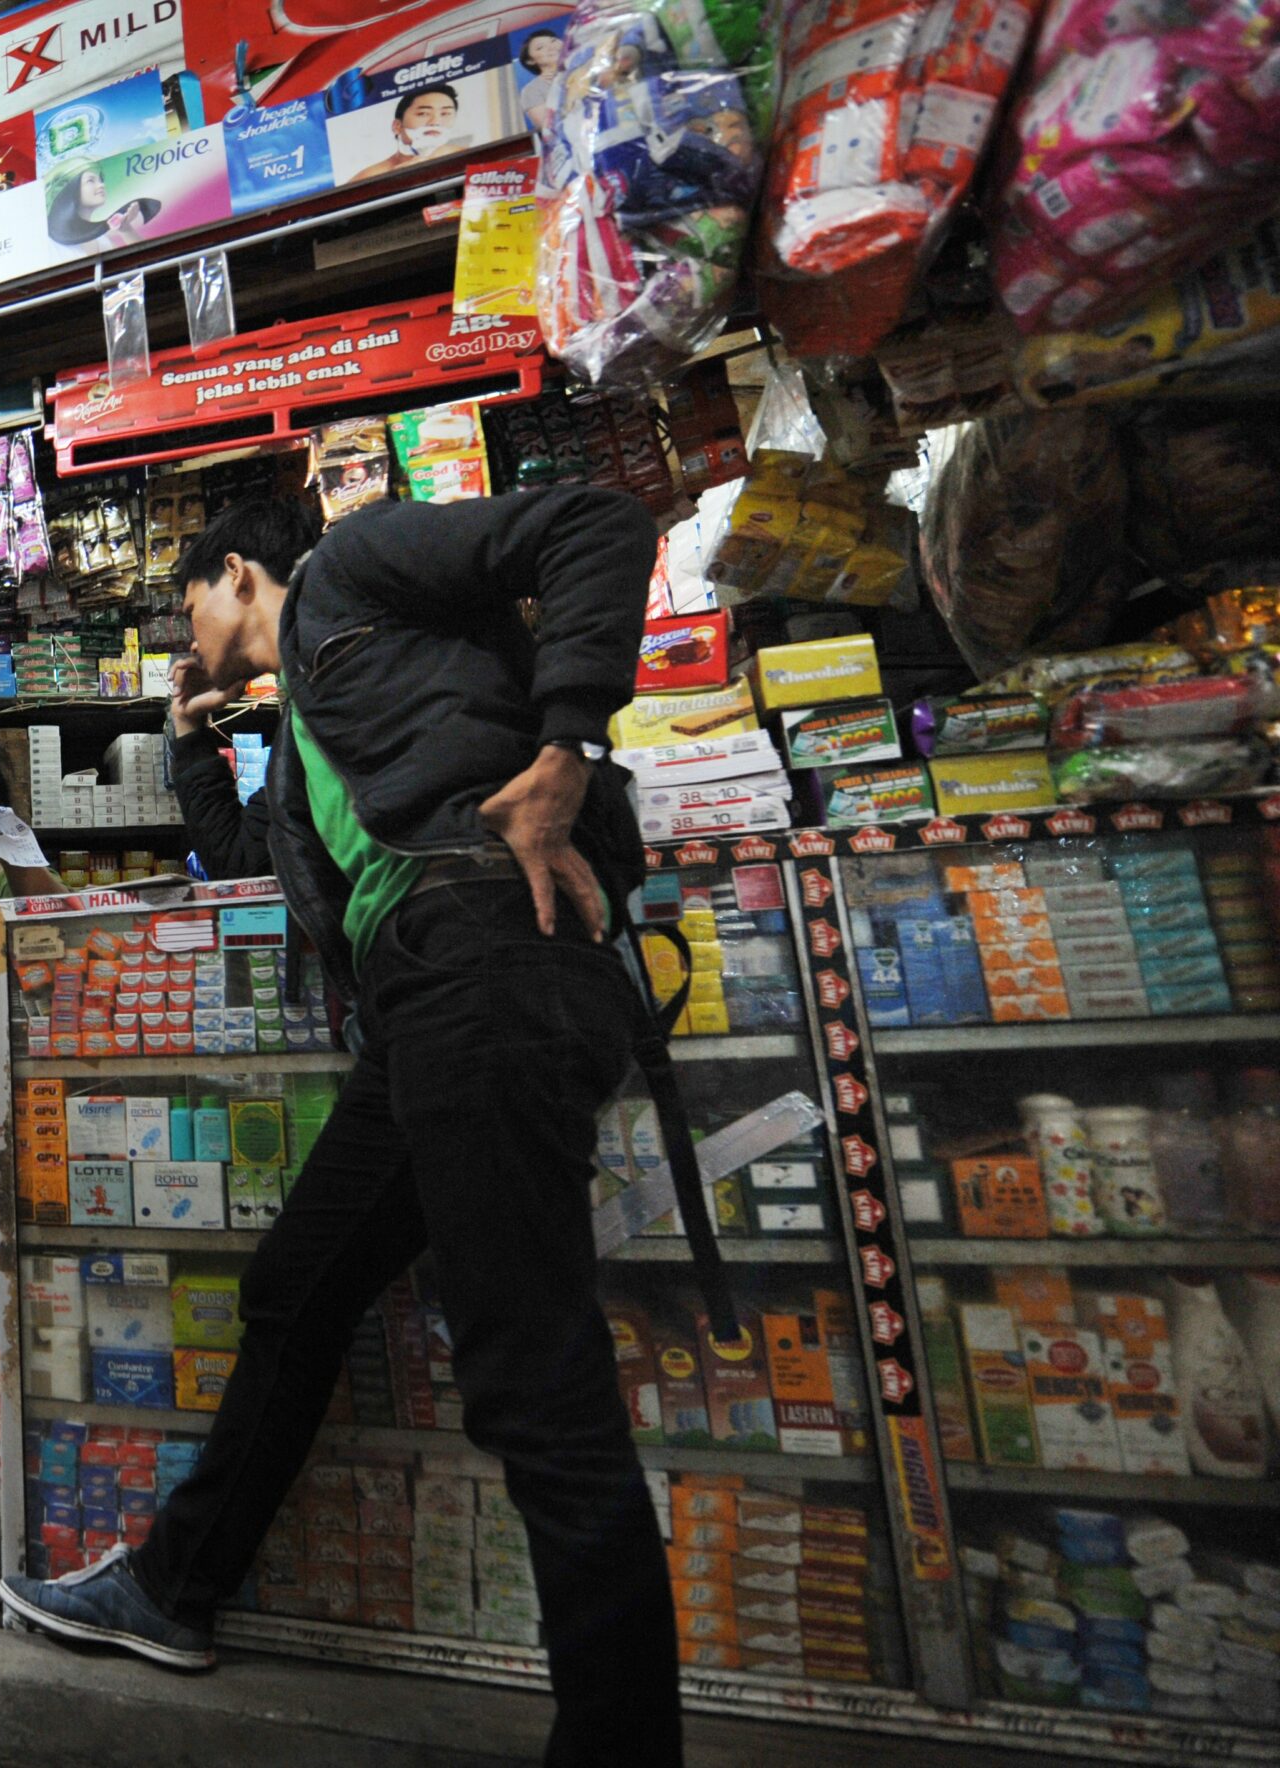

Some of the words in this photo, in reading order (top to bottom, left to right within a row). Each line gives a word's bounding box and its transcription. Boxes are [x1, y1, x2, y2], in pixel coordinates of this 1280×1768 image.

[80, 0, 177, 50] MILD
[394, 54, 464, 84] Gillette
[238, 111, 307, 141] shoulders
[125, 139, 210, 178] Rejoice
[470, 171, 526, 185] Gillette
[426, 341, 485, 363] Good
[490, 329, 535, 360] Day
[161, 367, 229, 388] Semua
[233, 357, 284, 380] yang
[288, 345, 326, 363] ada
[330, 337, 353, 355] di
[357, 329, 400, 350] sini
[196, 383, 244, 405] jelas
[248, 373, 302, 394] lebih
[306, 360, 361, 381] enak
[413, 465, 450, 481] Good
[452, 460, 479, 477] Day
[679, 791, 702, 804] 38
[720, 786, 738, 799] 10
[672, 816, 694, 829] 38
[712, 812, 731, 825] 10
[1052, 818, 1090, 832] KIWI
[1118, 813, 1157, 828] KIWI
[925, 827, 962, 842] KIWI
[988, 823, 1025, 837] KIWI
[796, 841, 830, 855] KIWI
[857, 836, 892, 850] KIWI
[683, 851, 713, 864] KIWI
[740, 846, 772, 860] KIWI
[803, 873, 820, 904] KIWI
[89, 891, 140, 908] HALIM
[872, 970, 902, 983] 44
[819, 976, 837, 1007] KIWI
[33, 1086, 57, 1097] GPU
[837, 1078, 856, 1112] KIWI
[77, 1103, 112, 1115] Visine
[36, 1126, 60, 1138] GPU
[37, 1152, 61, 1164] GPU
[75, 1166, 124, 1177] LOTTE
[155, 1174, 199, 1187] ROHTO
[855, 1195, 872, 1229] KIWI
[188, 1292, 233, 1305] WOODS
[873, 1305, 889, 1342] KIWI
[96, 1387, 112, 1398] 125
